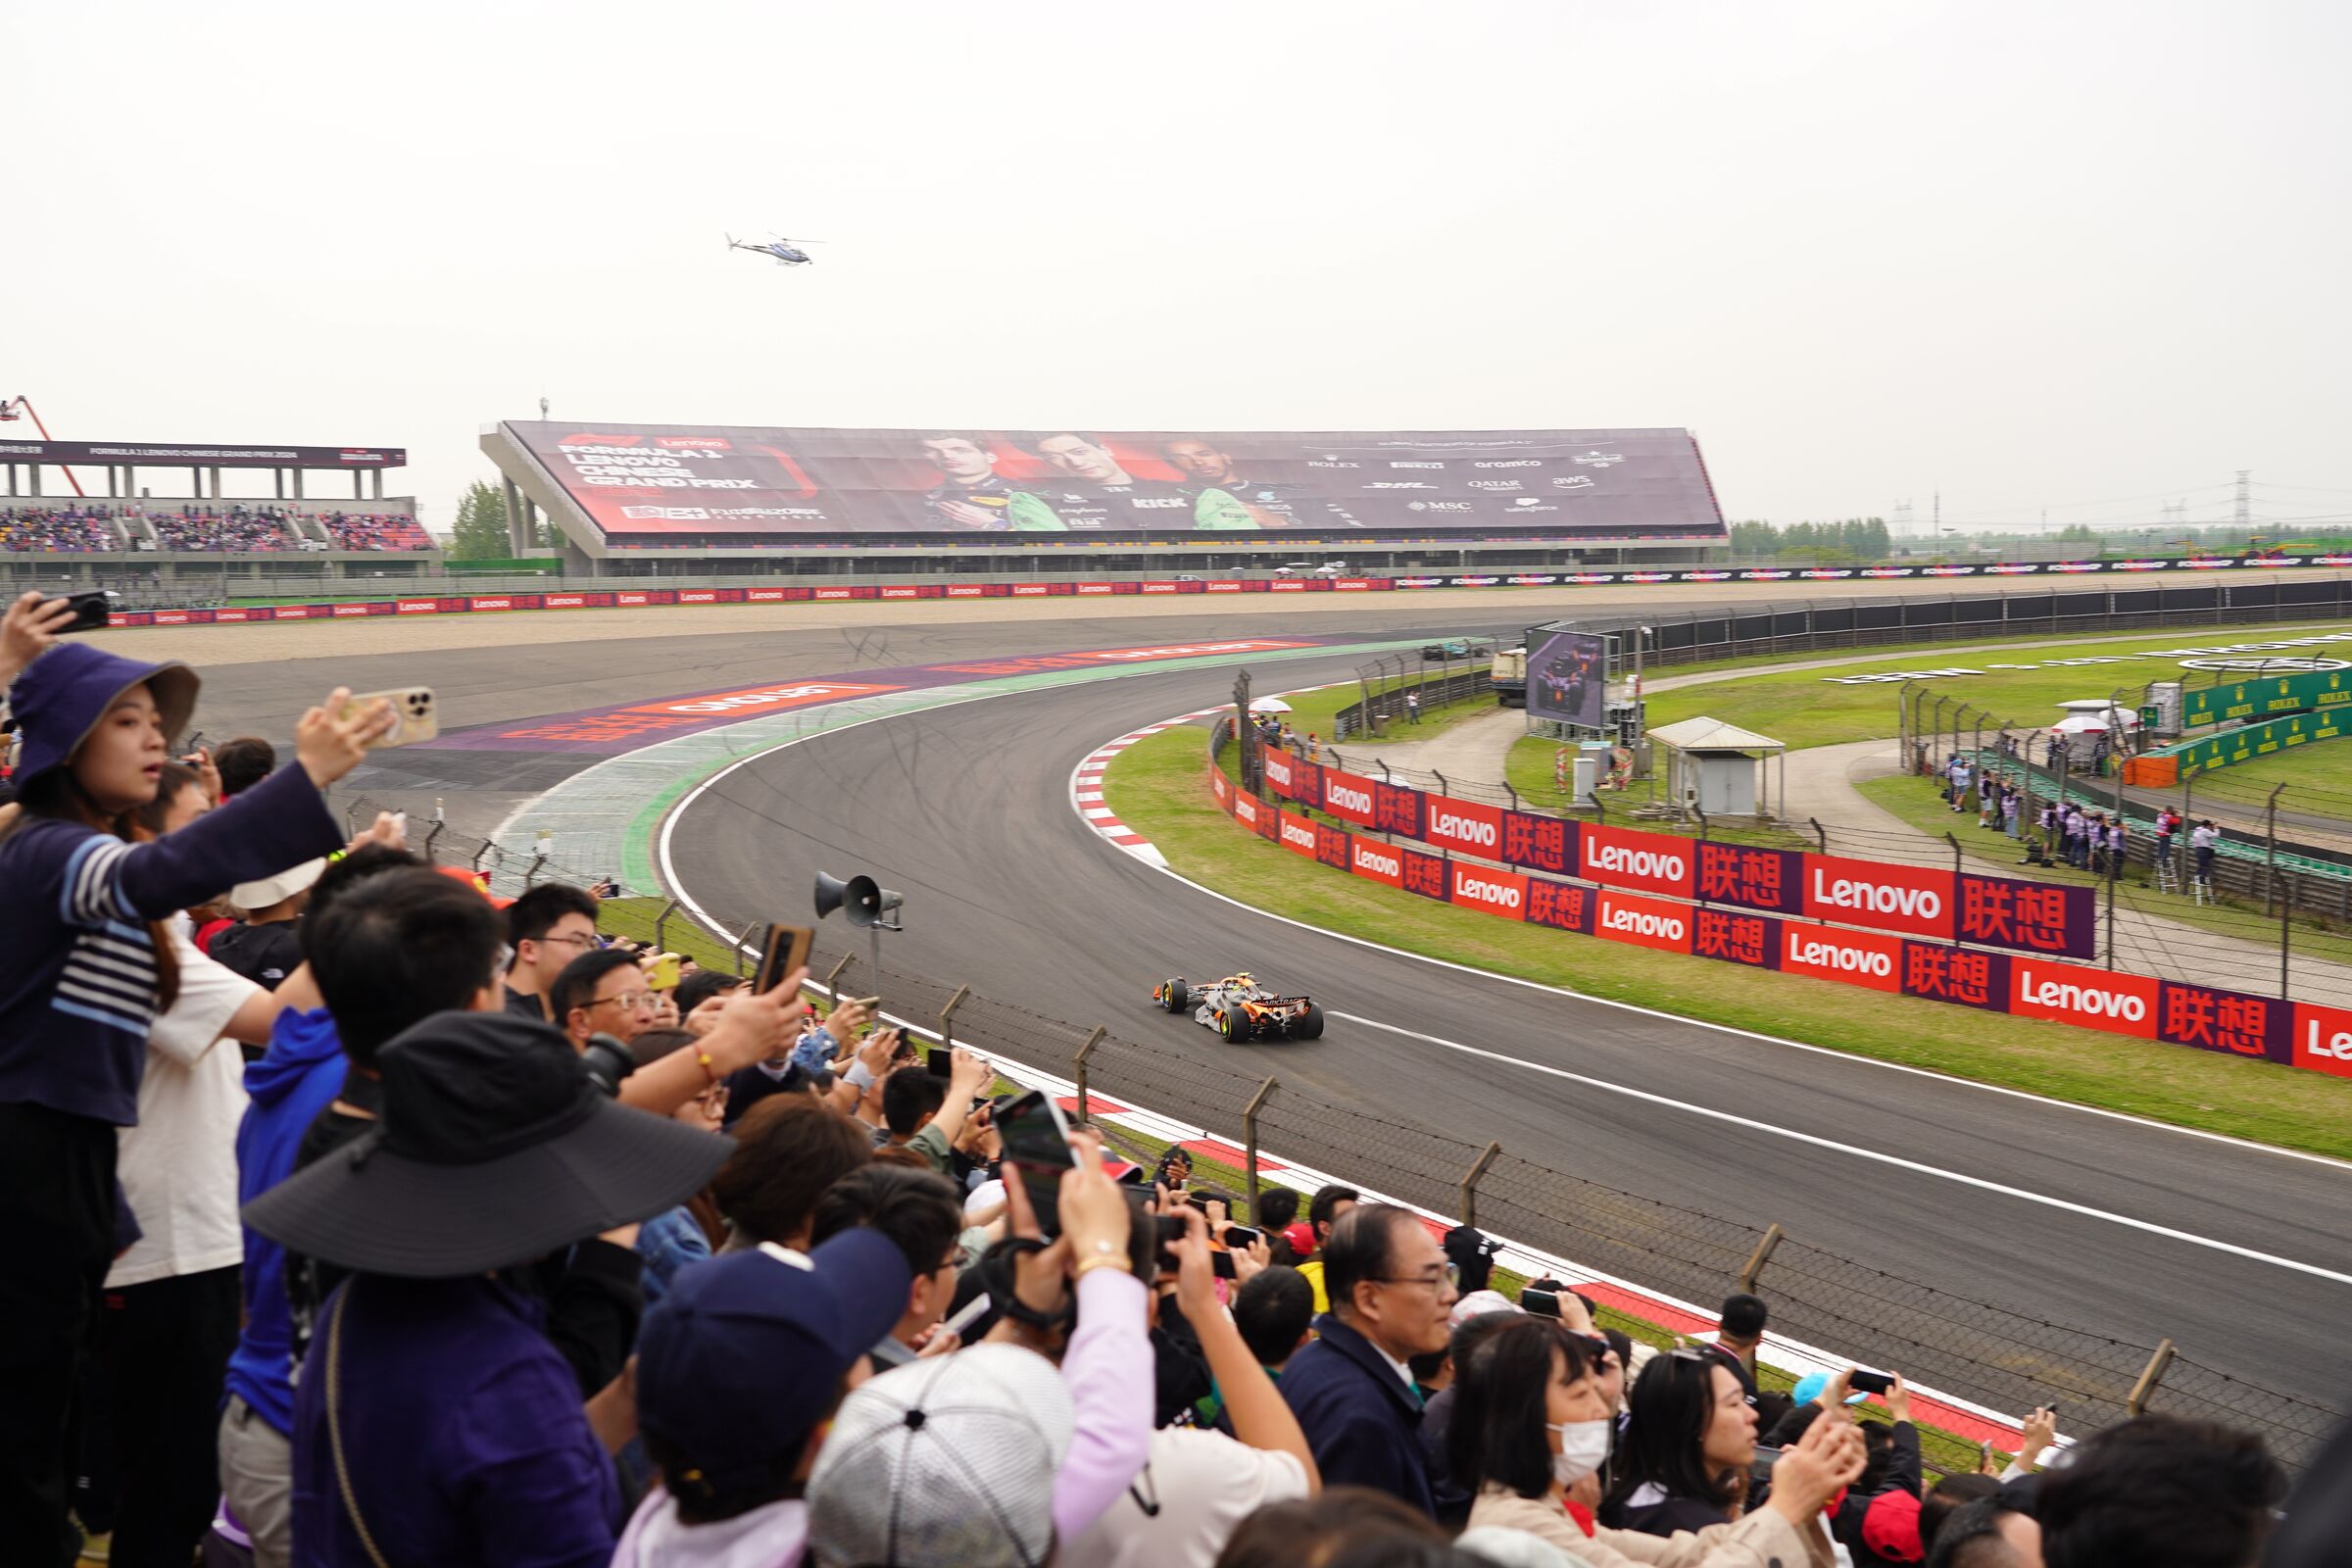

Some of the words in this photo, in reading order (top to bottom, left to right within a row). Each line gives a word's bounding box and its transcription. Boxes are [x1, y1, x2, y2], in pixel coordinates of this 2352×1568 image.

[557, 444, 705, 459] FORMULA
[701, 449, 724, 459] 1
[660, 438, 723, 448] Lenovo
[564, 453, 683, 467] LENOVO
[574, 465, 697, 478] CHINESE
[1474, 460, 1543, 468] aramco
[582, 475, 688, 488] GRAND
[686, 477, 762, 489] PRIX
[1467, 479, 1522, 488] QATAR
[1552, 475, 1590, 485] aws
[1131, 498, 1189, 509] KICK
[1427, 502, 1472, 511] MSC
[399, 602, 436, 612] Lenovo
[473, 599, 511, 609] Lenovo
[547, 597, 583, 606] Lenovo
[680, 593, 715, 602] Lenovo
[749, 591, 783, 600] Lenovo
[1097, 639, 1291, 659] Lenovo
[1818, 667, 1986, 685] MEET
[668, 685, 871, 711] Lenovo
[2267, 697, 2301, 711] ROLEX
[2316, 691, 2352, 705] ROLEX
[1265, 753, 1292, 787] Lenovo
[1326, 777, 1372, 814] Lenovo
[1377, 785, 1417, 836] 联想
[1281, 818, 1315, 849] Lenovo
[1430, 805, 1496, 847] Lenovo
[1504, 813, 1565, 871] 联想
[1354, 844, 1399, 877] Lenovo
[1587, 836, 1685, 882] Lenovo
[1455, 871, 1521, 908] Lenovo
[1700, 845, 1783, 908] 联想
[1528, 880, 1585, 930] 联想
[1813, 868, 1941, 919] Lenovo
[1601, 902, 1685, 940] Lenovo
[1961, 879, 2068, 951] 联想
[1696, 910, 1764, 963] 联想
[1789, 933, 1892, 977] Lenovo
[1906, 944, 1989, 1004] 联想
[2021, 971, 2146, 1022] Lenovo
[2164, 986, 2267, 1055] 联想
